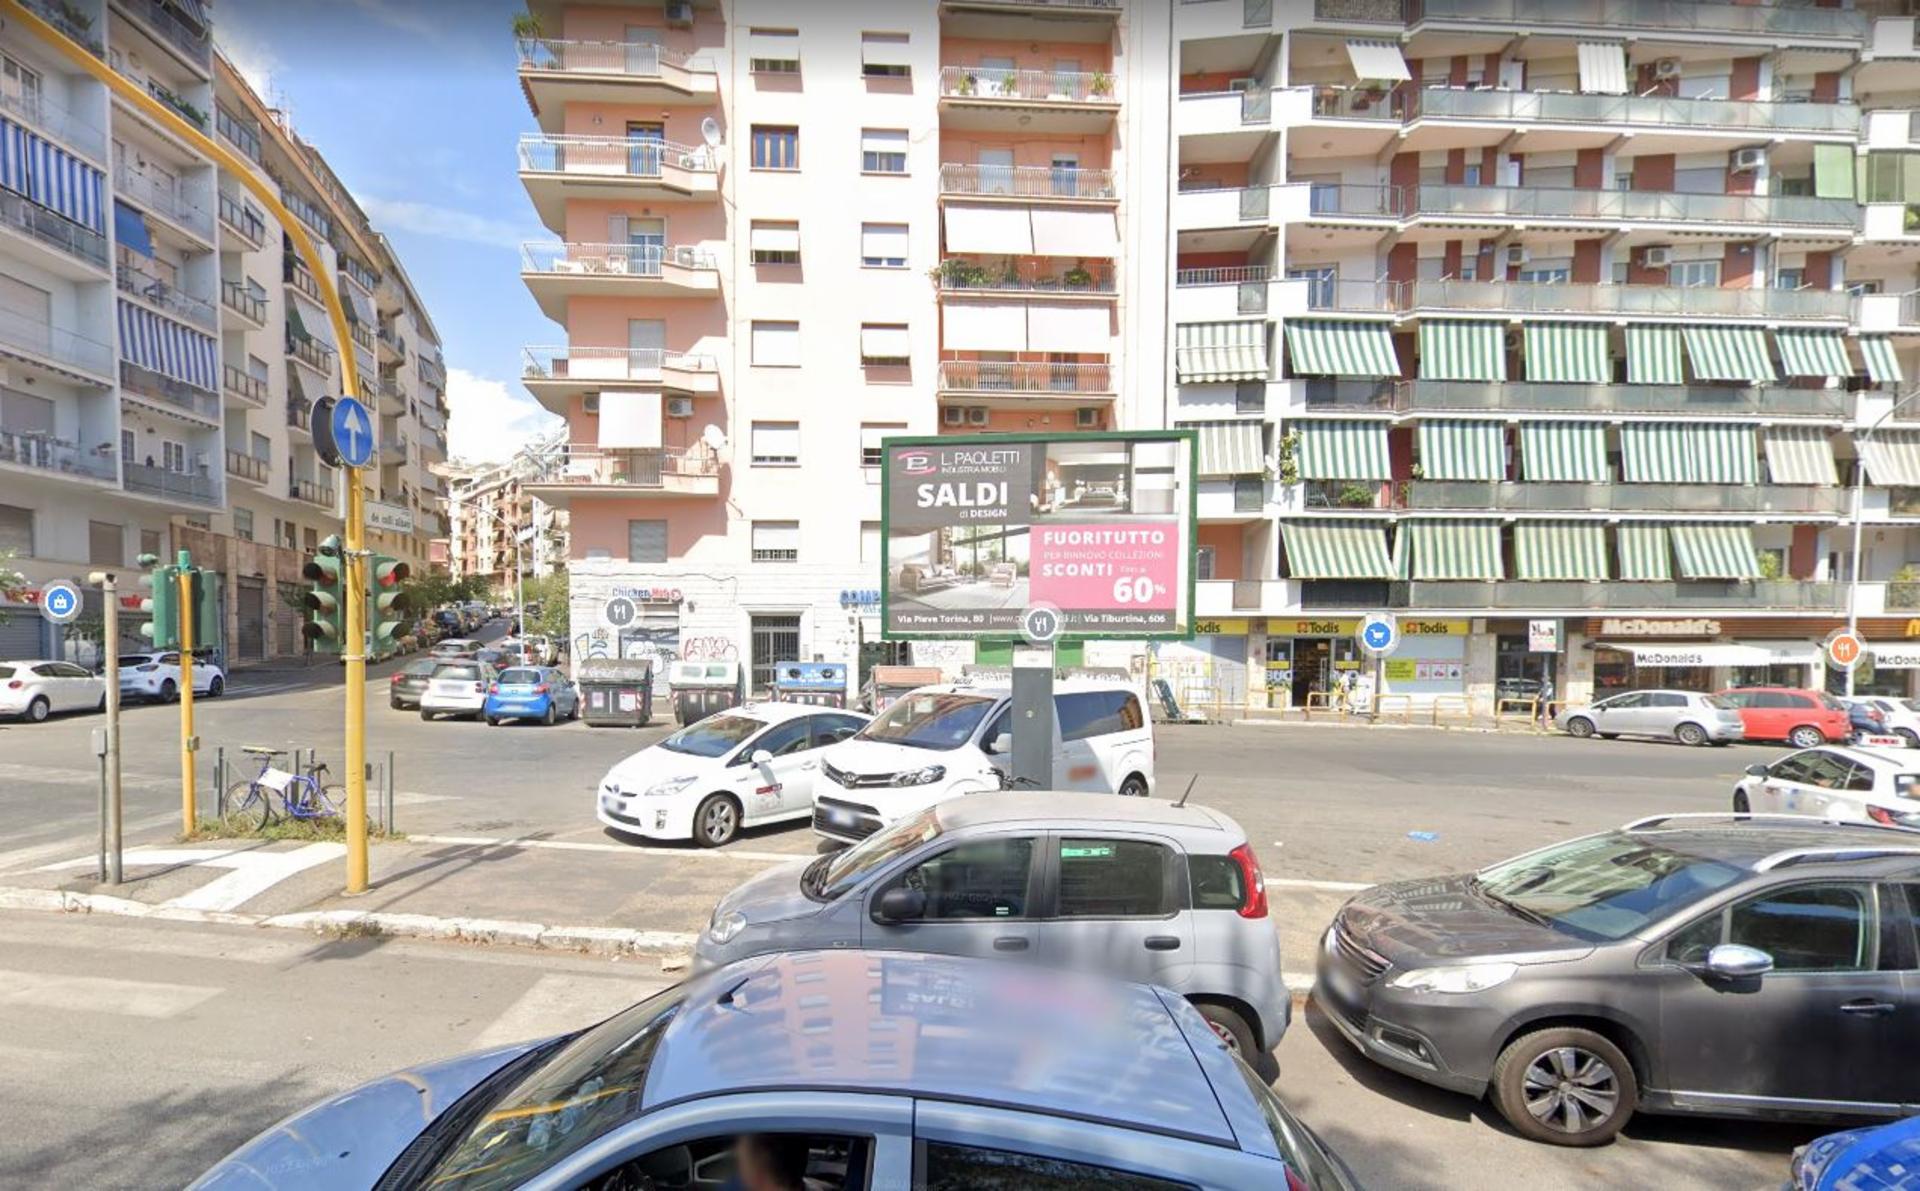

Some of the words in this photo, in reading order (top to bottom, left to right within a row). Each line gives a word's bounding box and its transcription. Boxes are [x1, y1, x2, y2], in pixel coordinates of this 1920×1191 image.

[941, 452, 953, 466] L.
[955, 450, 1020, 465] PAOLETTI
[917, 481, 1008, 508] SALDI
[969, 508, 1008, 518] DESIGN
[1043, 530, 1165, 545] FUORITUTTO
[1042, 563, 1113, 577] SCONTI
[897, 615, 912, 623] Via
[1083, 614, 1099, 623] Via
[1101, 613, 1147, 624] Tiburtina,
[1194, 621, 1221, 634] odis
[1309, 621, 1340, 634] Todis
[1419, 621, 1448, 634] Todis
[1601, 619, 1721, 635] McDonald's
